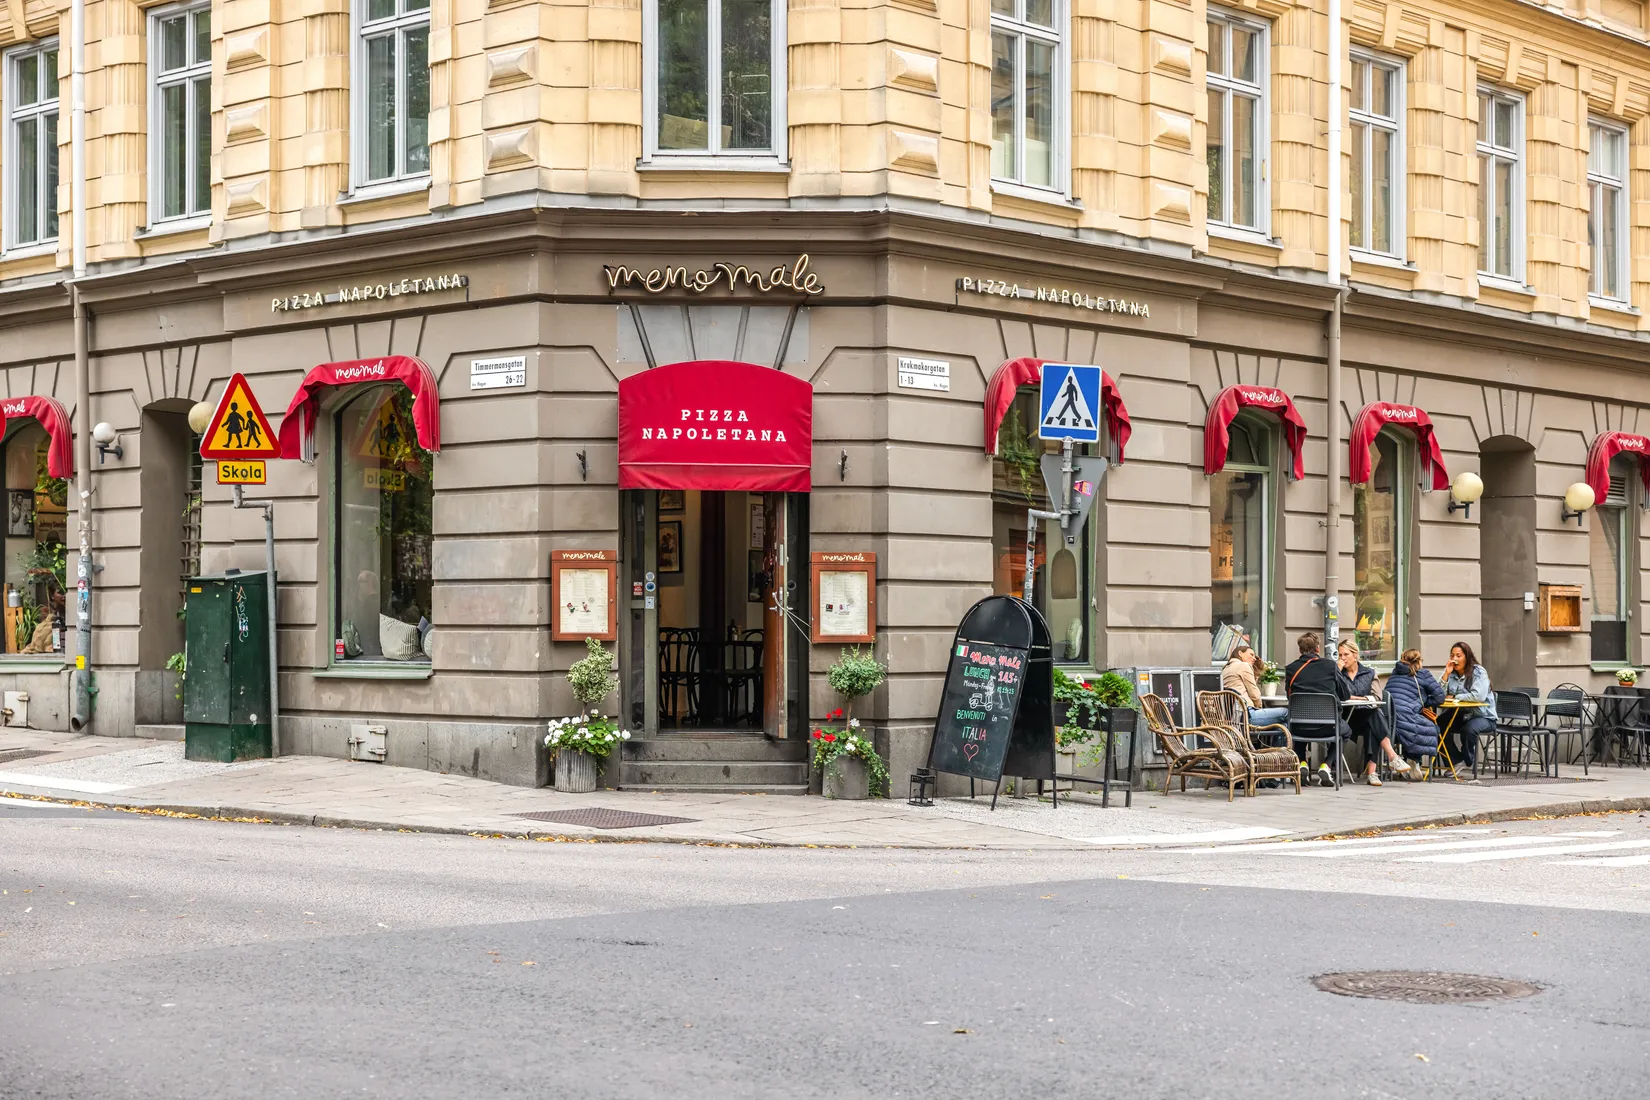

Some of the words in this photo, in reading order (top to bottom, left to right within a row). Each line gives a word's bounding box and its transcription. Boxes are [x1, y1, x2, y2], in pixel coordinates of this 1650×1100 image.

[271, 291, 324, 313] PIZZA
[339, 273, 462, 303] NAPOLETANA
[962, 276, 1020, 299] PIZZA
[1036, 286, 1150, 318] NAPOLETANA
[475, 360, 523, 371] Timmermansgatan
[681, 409, 749, 422] PIZZA
[642, 428, 787, 442] NAPOLETANA
[222, 465, 262, 479] Skola
[963, 666, 991, 680] LUNCH
[956, 709, 986, 720] BENVENUTI
[961, 726, 987, 741] ITALIA
